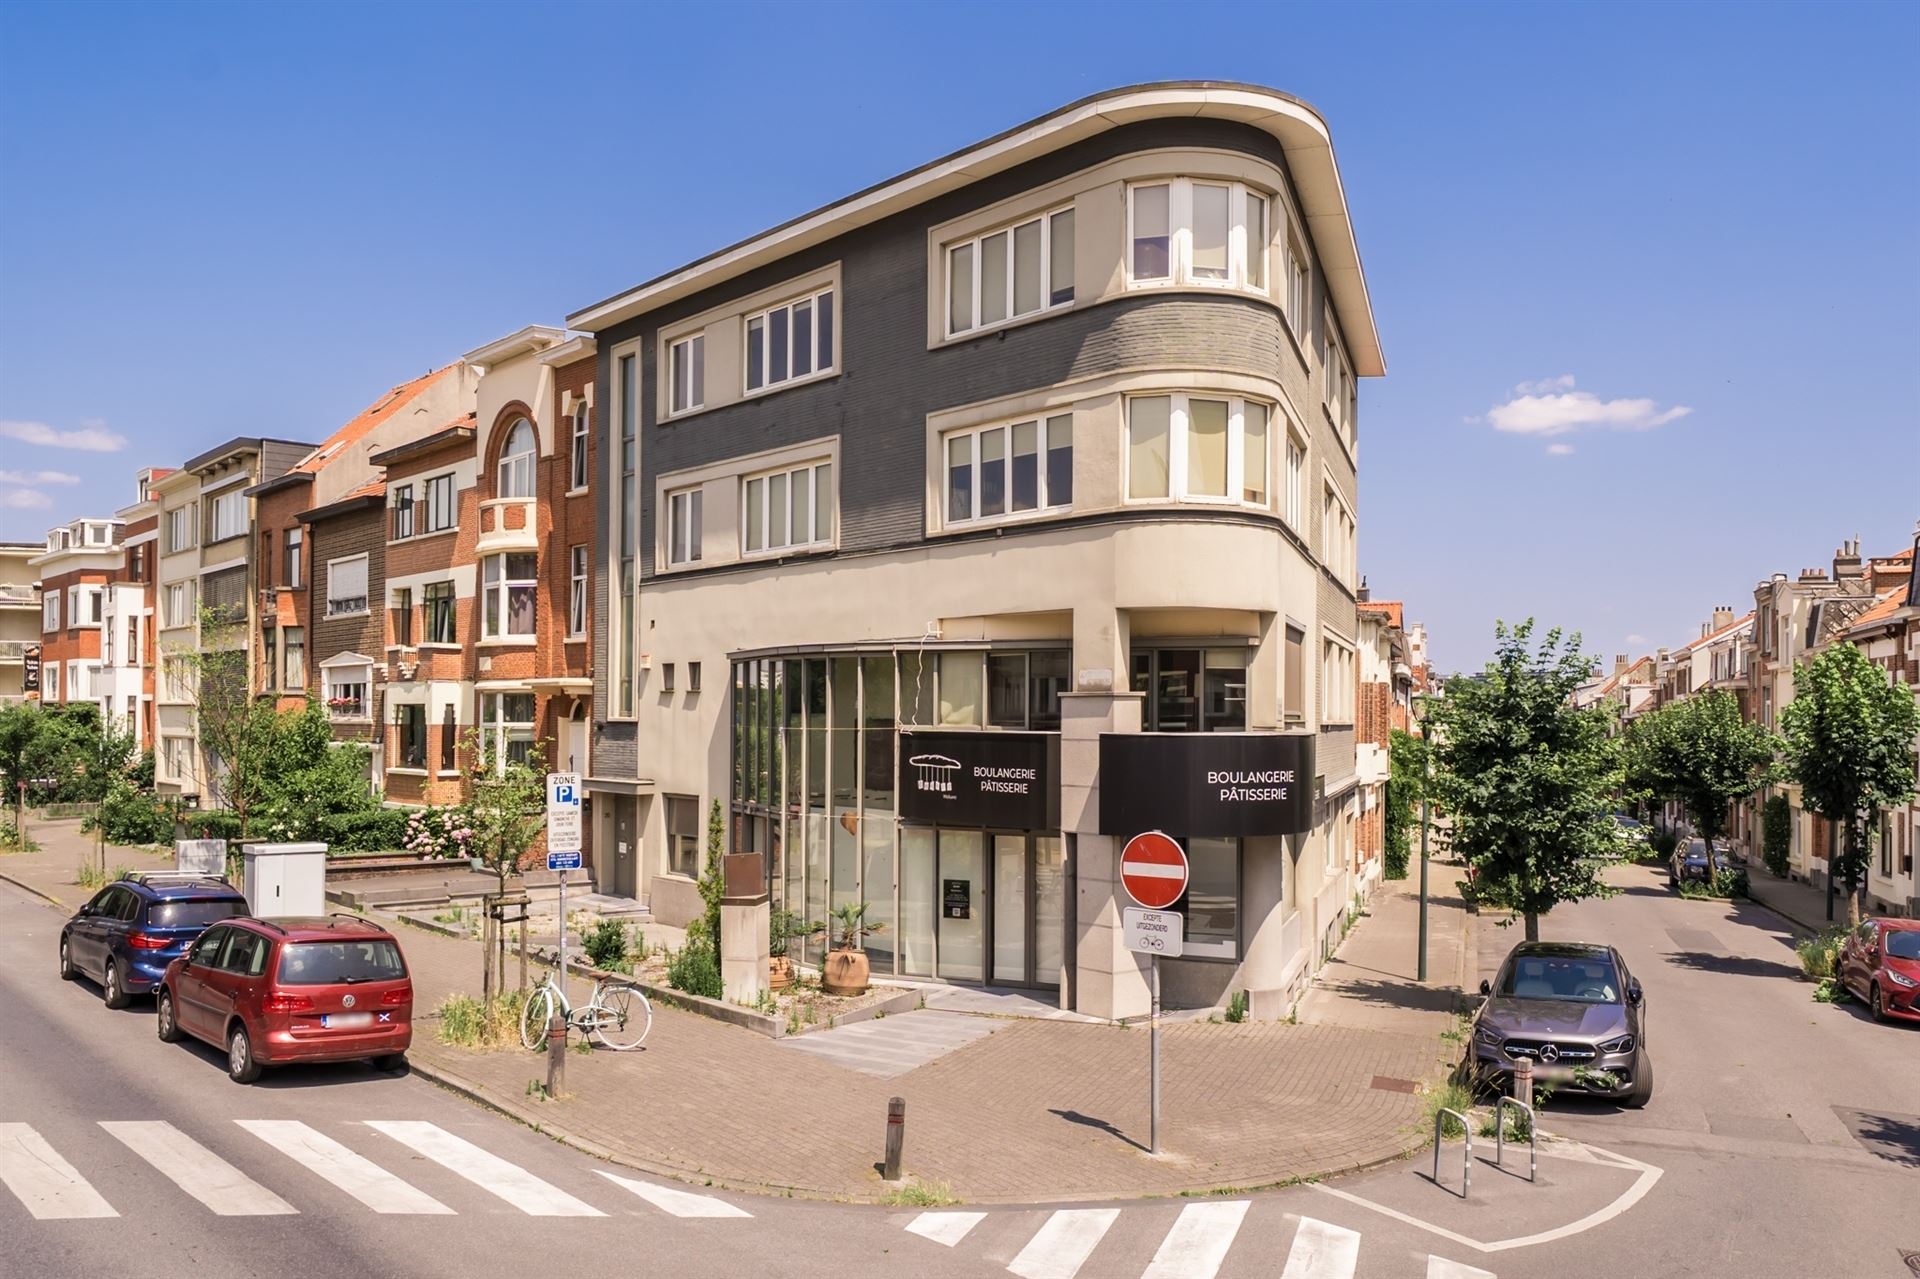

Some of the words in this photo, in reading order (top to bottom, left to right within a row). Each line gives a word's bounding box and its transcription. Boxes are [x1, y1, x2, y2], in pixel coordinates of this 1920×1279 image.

[974, 767, 1036, 779] BOULANGERIE
[1208, 771, 1294, 784] BOULANGERIE
[554, 776, 576, 784] ZONE
[981, 780, 1028, 794] PÂTISSERIE
[1220, 786, 1288, 801] PÂTISSERIE
[559, 786, 570, 802] P
